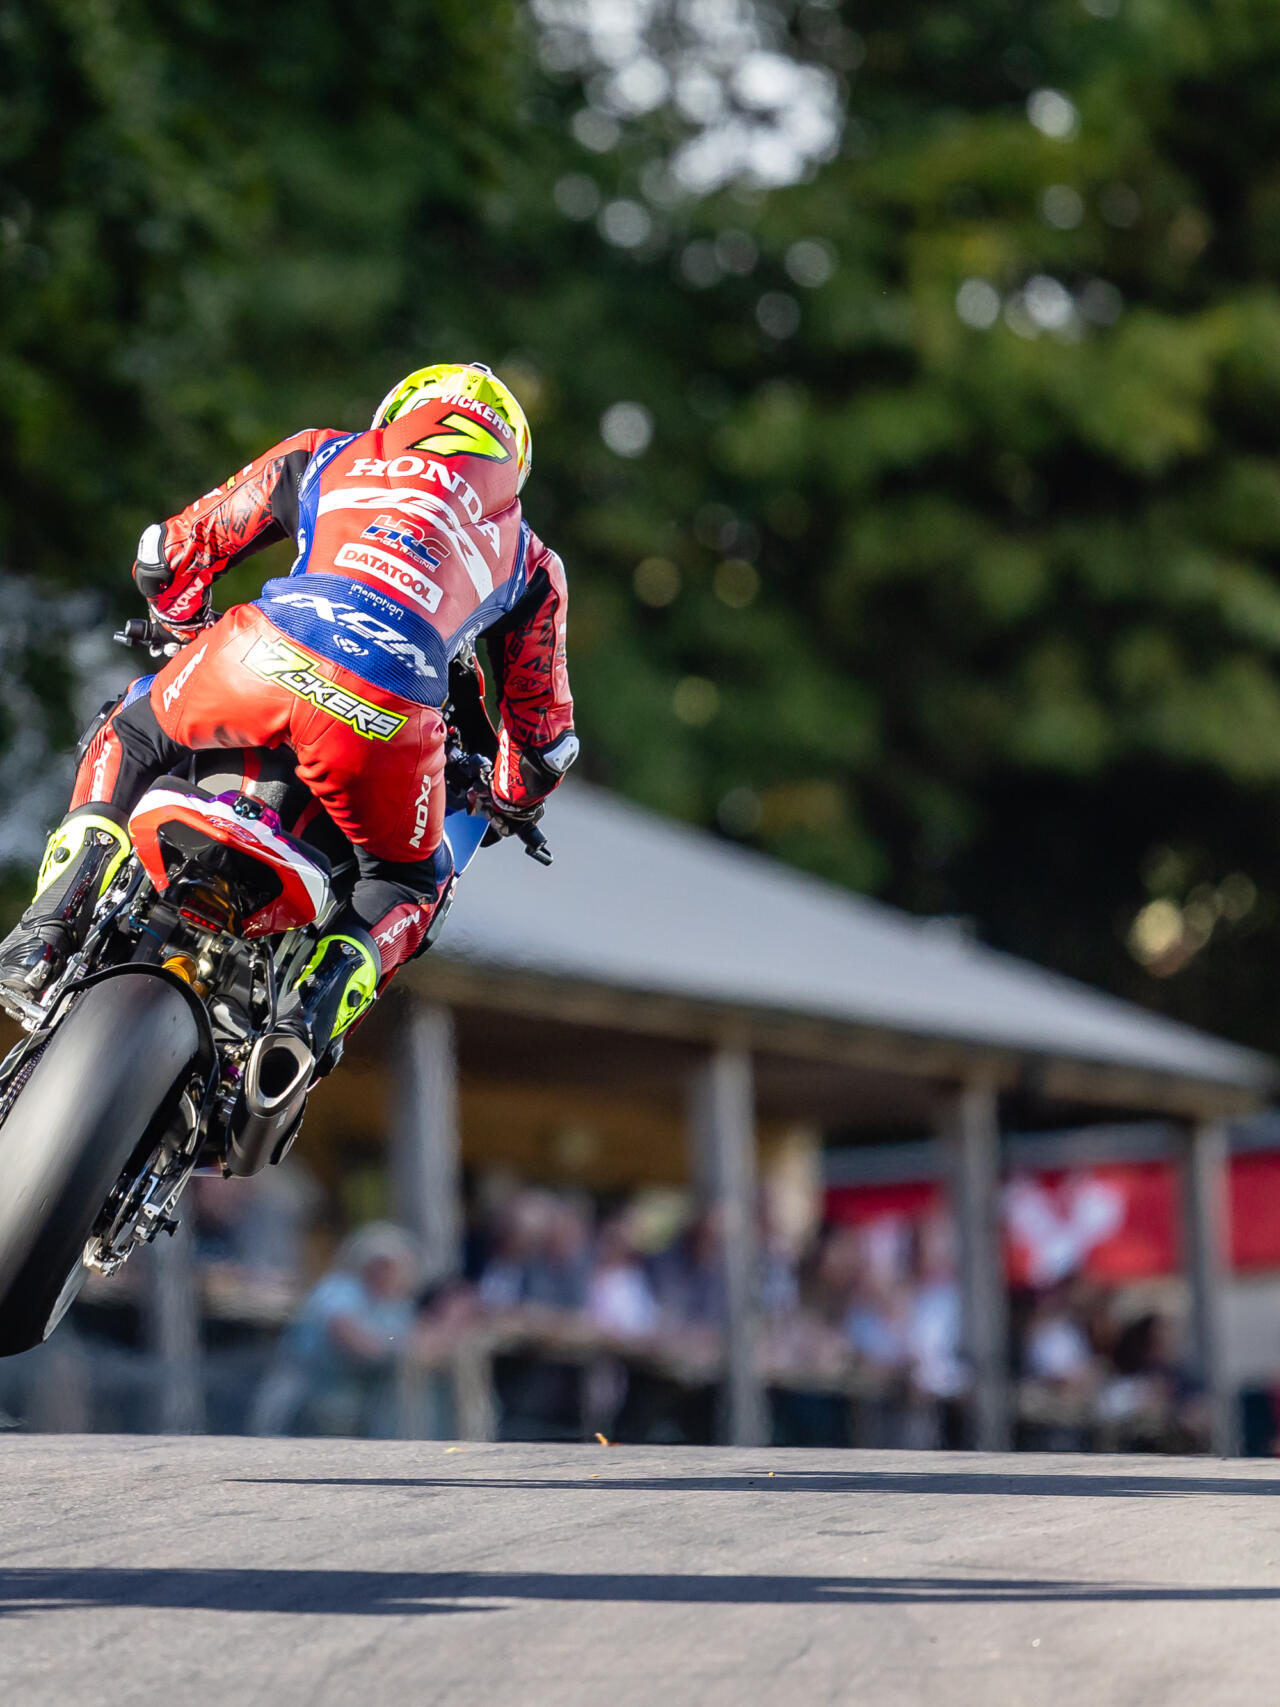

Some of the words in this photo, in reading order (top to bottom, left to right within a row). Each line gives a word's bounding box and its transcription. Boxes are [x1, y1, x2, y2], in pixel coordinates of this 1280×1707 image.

[404, 410, 513, 465] 7
[440, 393, 513, 439] VICKERS
[344, 455, 501, 560] HONDA
[360, 513, 451, 569] HRC
[166, 576, 205, 617] IXON
[343, 549, 432, 605] DATATOOL
[270, 592, 439, 679] IXON
[163, 642, 208, 712] IXON
[408, 774, 432, 849] IXON
